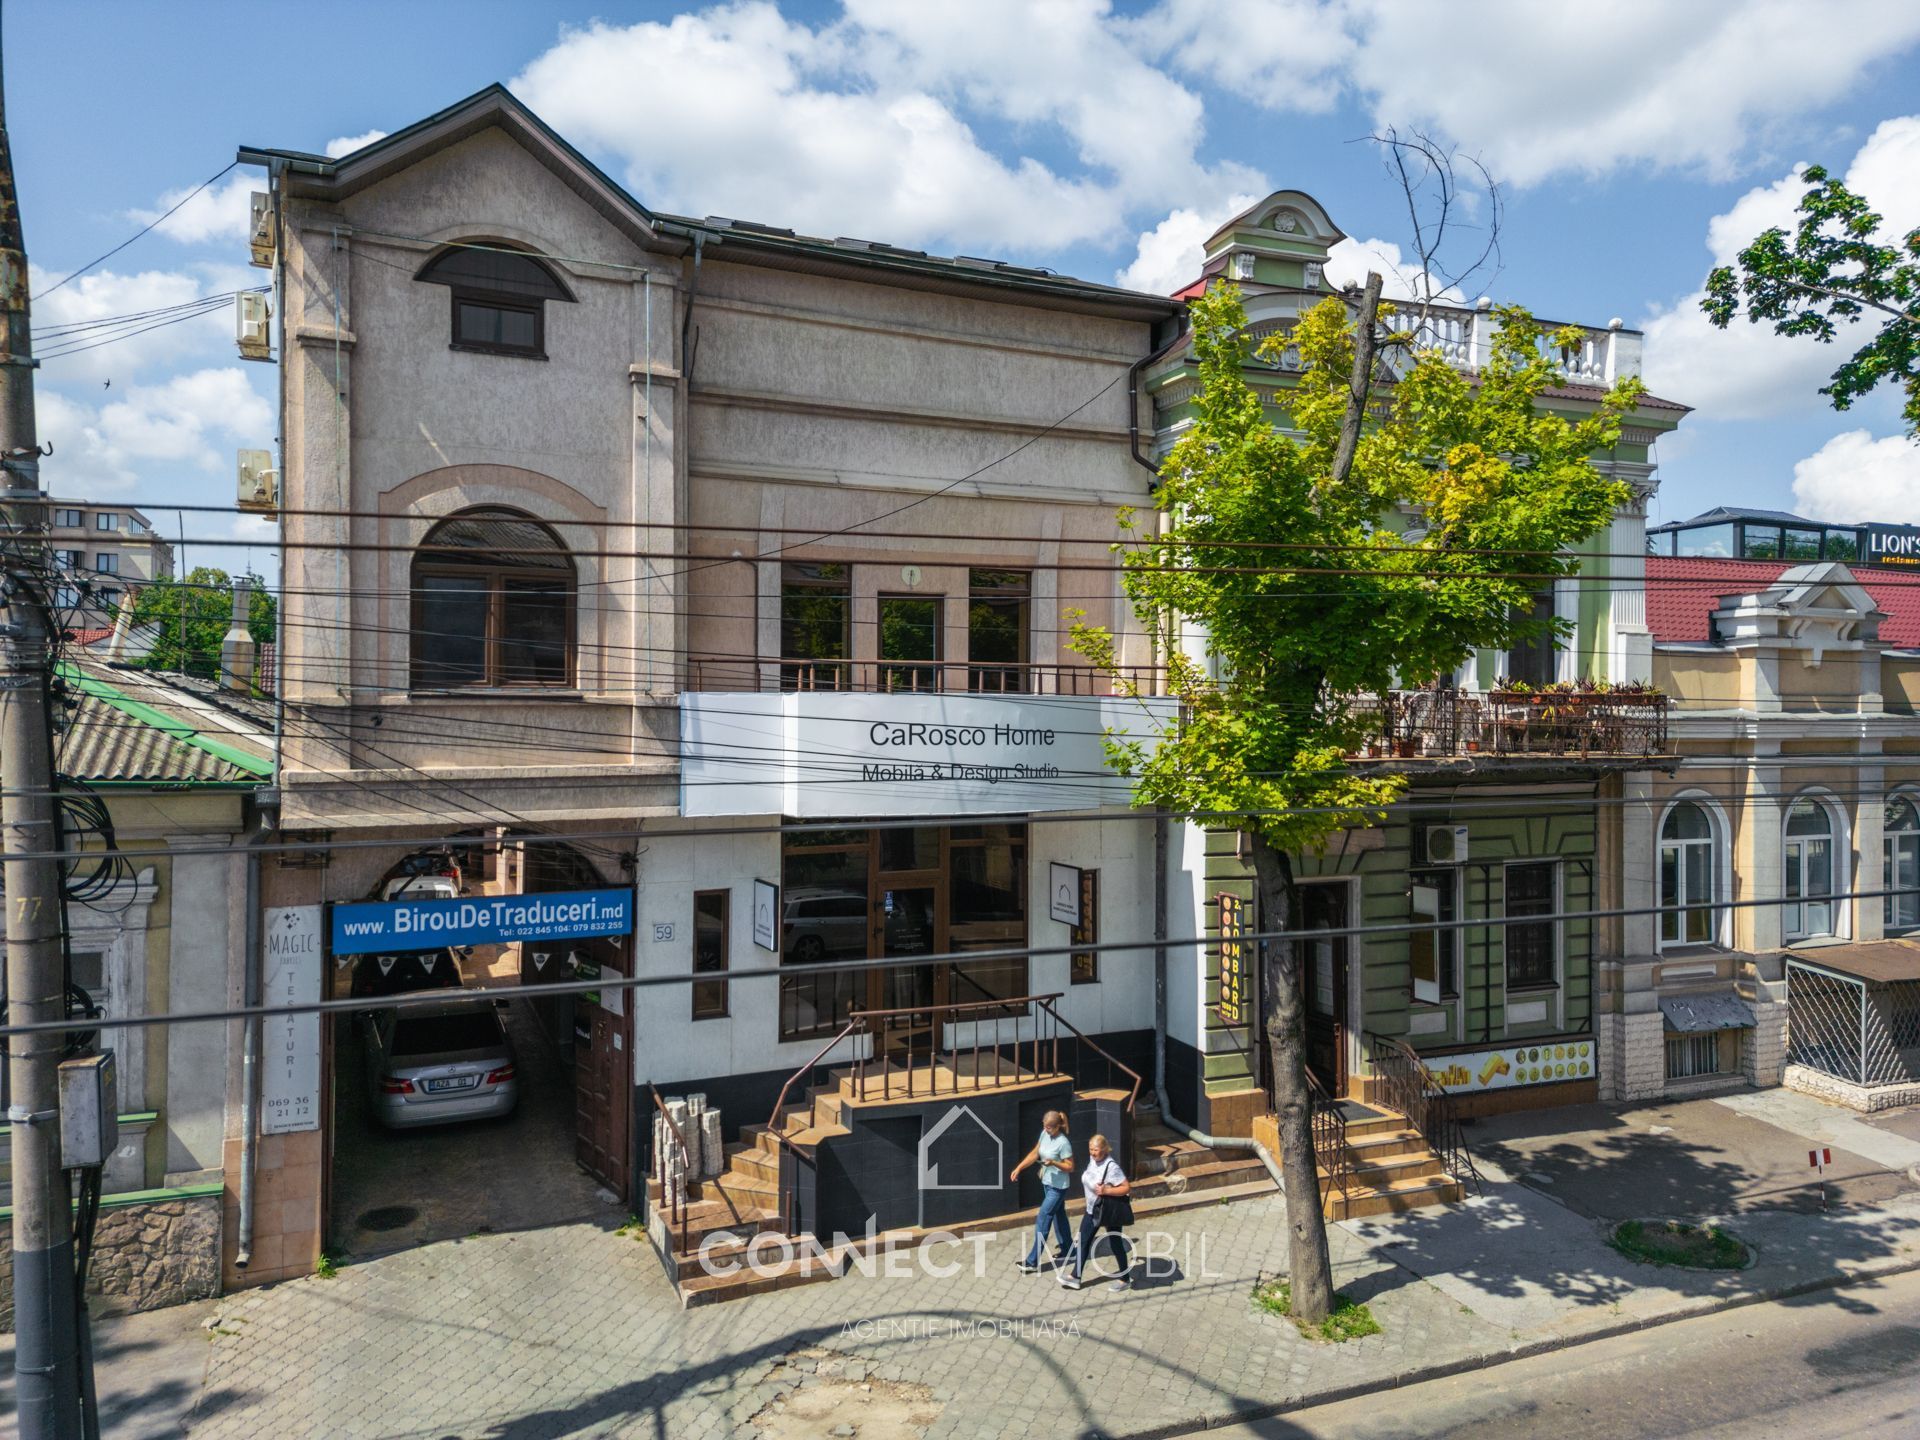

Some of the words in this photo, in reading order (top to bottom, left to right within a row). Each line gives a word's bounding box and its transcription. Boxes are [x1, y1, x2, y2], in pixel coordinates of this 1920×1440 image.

[870, 722, 985, 746] CaRosco
[995, 723, 1055, 746] Home
[931, 764, 943, 780] &
[951, 763, 1008, 784] Design
[1014, 763, 1059, 780] Studio
[16, 896, 42, 922] 77
[499, 928, 515, 936] Tel:
[517, 927, 533, 935] 022
[535, 926, 551, 934] 845
[573, 923, 588, 931] 079
[590, 922, 606, 930] 832
[607, 921, 623, 929] 255
[656, 925, 672, 940] 59
[269, 933, 314, 955] MAGIC
[1232, 912, 1240, 1020] LOMBARD
[268, 1098, 290, 1107] 069
